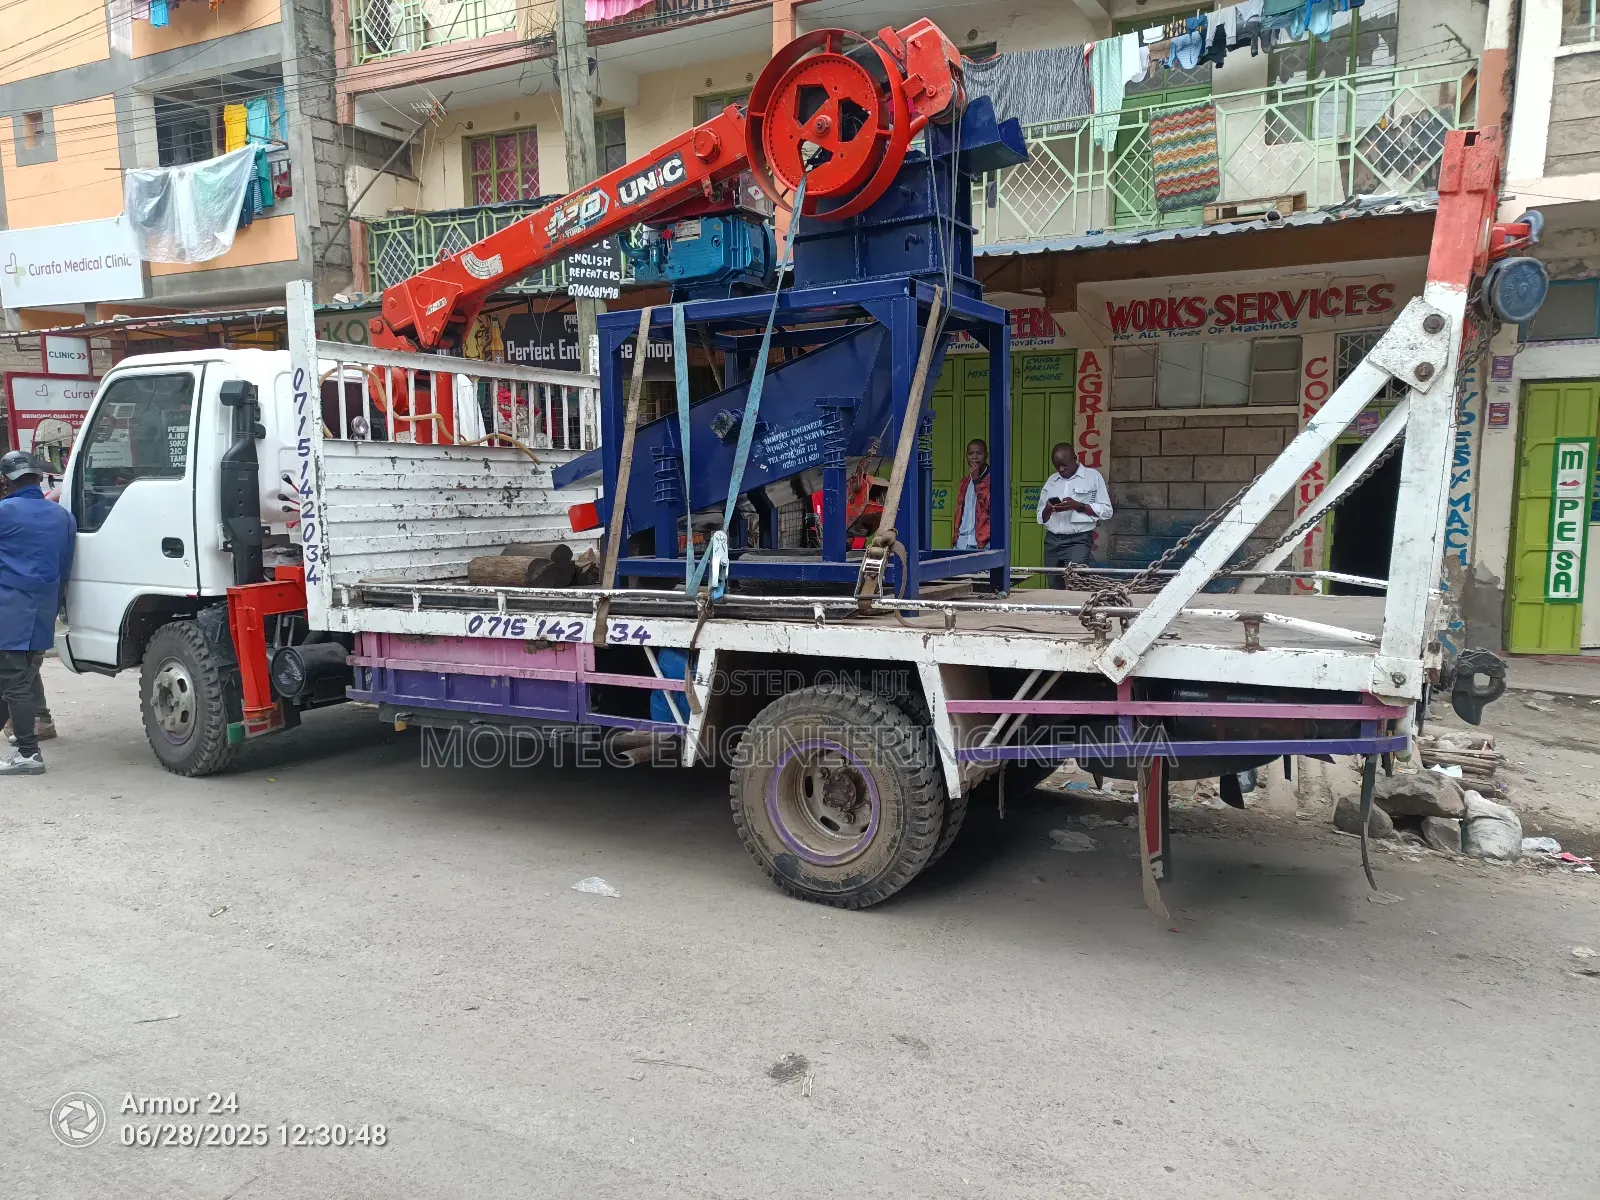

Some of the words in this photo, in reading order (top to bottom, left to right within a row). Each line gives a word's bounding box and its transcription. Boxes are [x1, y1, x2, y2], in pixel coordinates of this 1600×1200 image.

[619, 158, 684, 204] UNIC
[28, 261, 62, 276] Curafa
[64, 256, 102, 272] Medical
[105, 253, 132, 268] Clinic
[569, 253, 613, 267] ENGLISH
[569, 267, 621, 281] REPEATERS
[568, 283, 619, 299] 0700681498
[1105, 296, 1207, 333] WORKS
[1214, 283, 1396, 326] SERVICES
[1139, 331, 1160, 339] ALL
[1166, 329, 1201, 338] Types
[1231, 320, 1298, 333] Machines
[506, 339, 555, 361] Perfect
[645, 339, 673, 362] hop
[950, 342, 980, 350] Turned
[48, 350, 75, 359] CLINIC
[967, 369, 989, 379] MIXE
[1024, 363, 1060, 372] MAKING
[1024, 373, 1063, 382] MACHINE
[790, 437, 803, 448] AND
[293, 367, 321, 586] 0715142034
[1552, 500, 1580, 593] PESA
[468, 615, 527, 637] 0715
[536, 619, 584, 641] 142
[609, 623, 651, 644] 34
